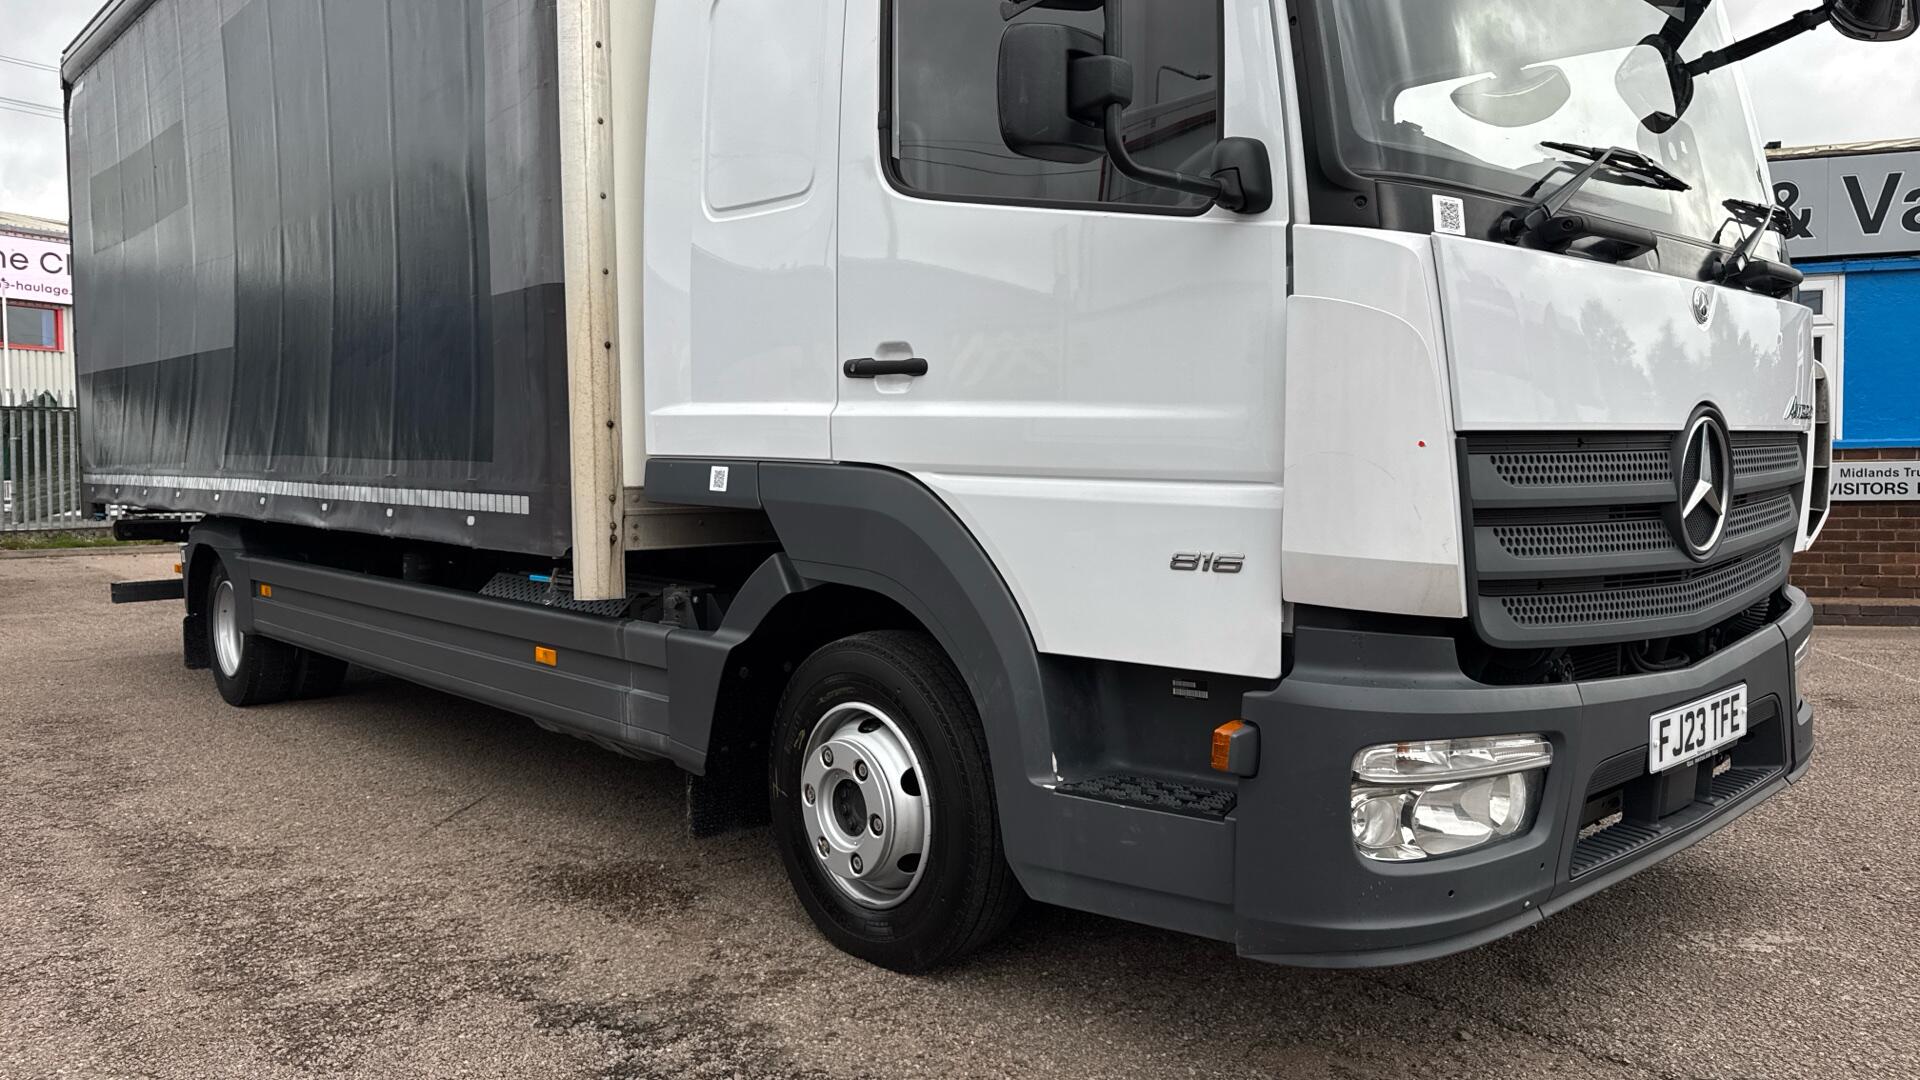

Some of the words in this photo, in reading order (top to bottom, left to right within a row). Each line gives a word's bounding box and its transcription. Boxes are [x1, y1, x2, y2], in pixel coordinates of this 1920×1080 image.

[1772, 180, 1815, 240] &
[1840, 467, 1899, 478] Midlands
[1170, 552, 1245, 573] 816
[1659, 707, 1706, 763] FJ23
[1711, 693, 1740, 740] TFE
